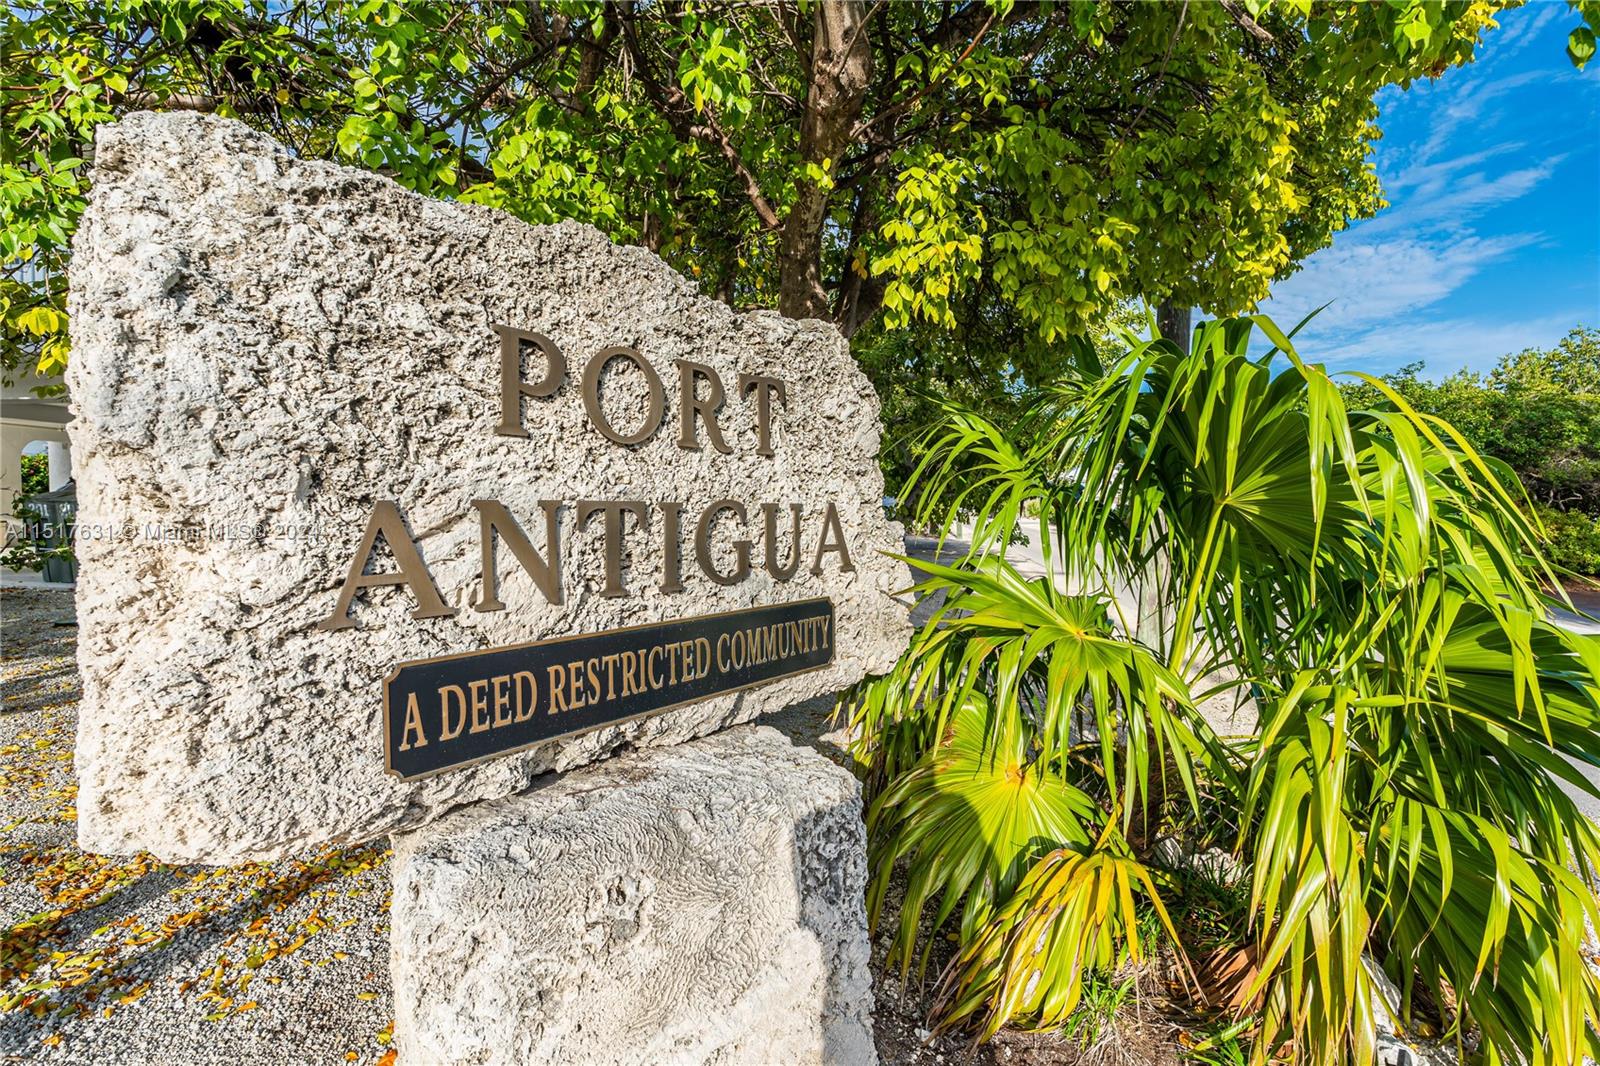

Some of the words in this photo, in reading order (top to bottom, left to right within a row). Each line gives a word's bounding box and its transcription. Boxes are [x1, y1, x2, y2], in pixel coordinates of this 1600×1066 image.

[493, 325, 786, 457] PORT
[318, 499, 856, 631] ANTIGUA
[399, 691, 429, 752] A
[437, 670, 539, 742] DEED
[546, 636, 712, 715] RESTRICTED
[716, 614, 831, 674] COMMUNITY
